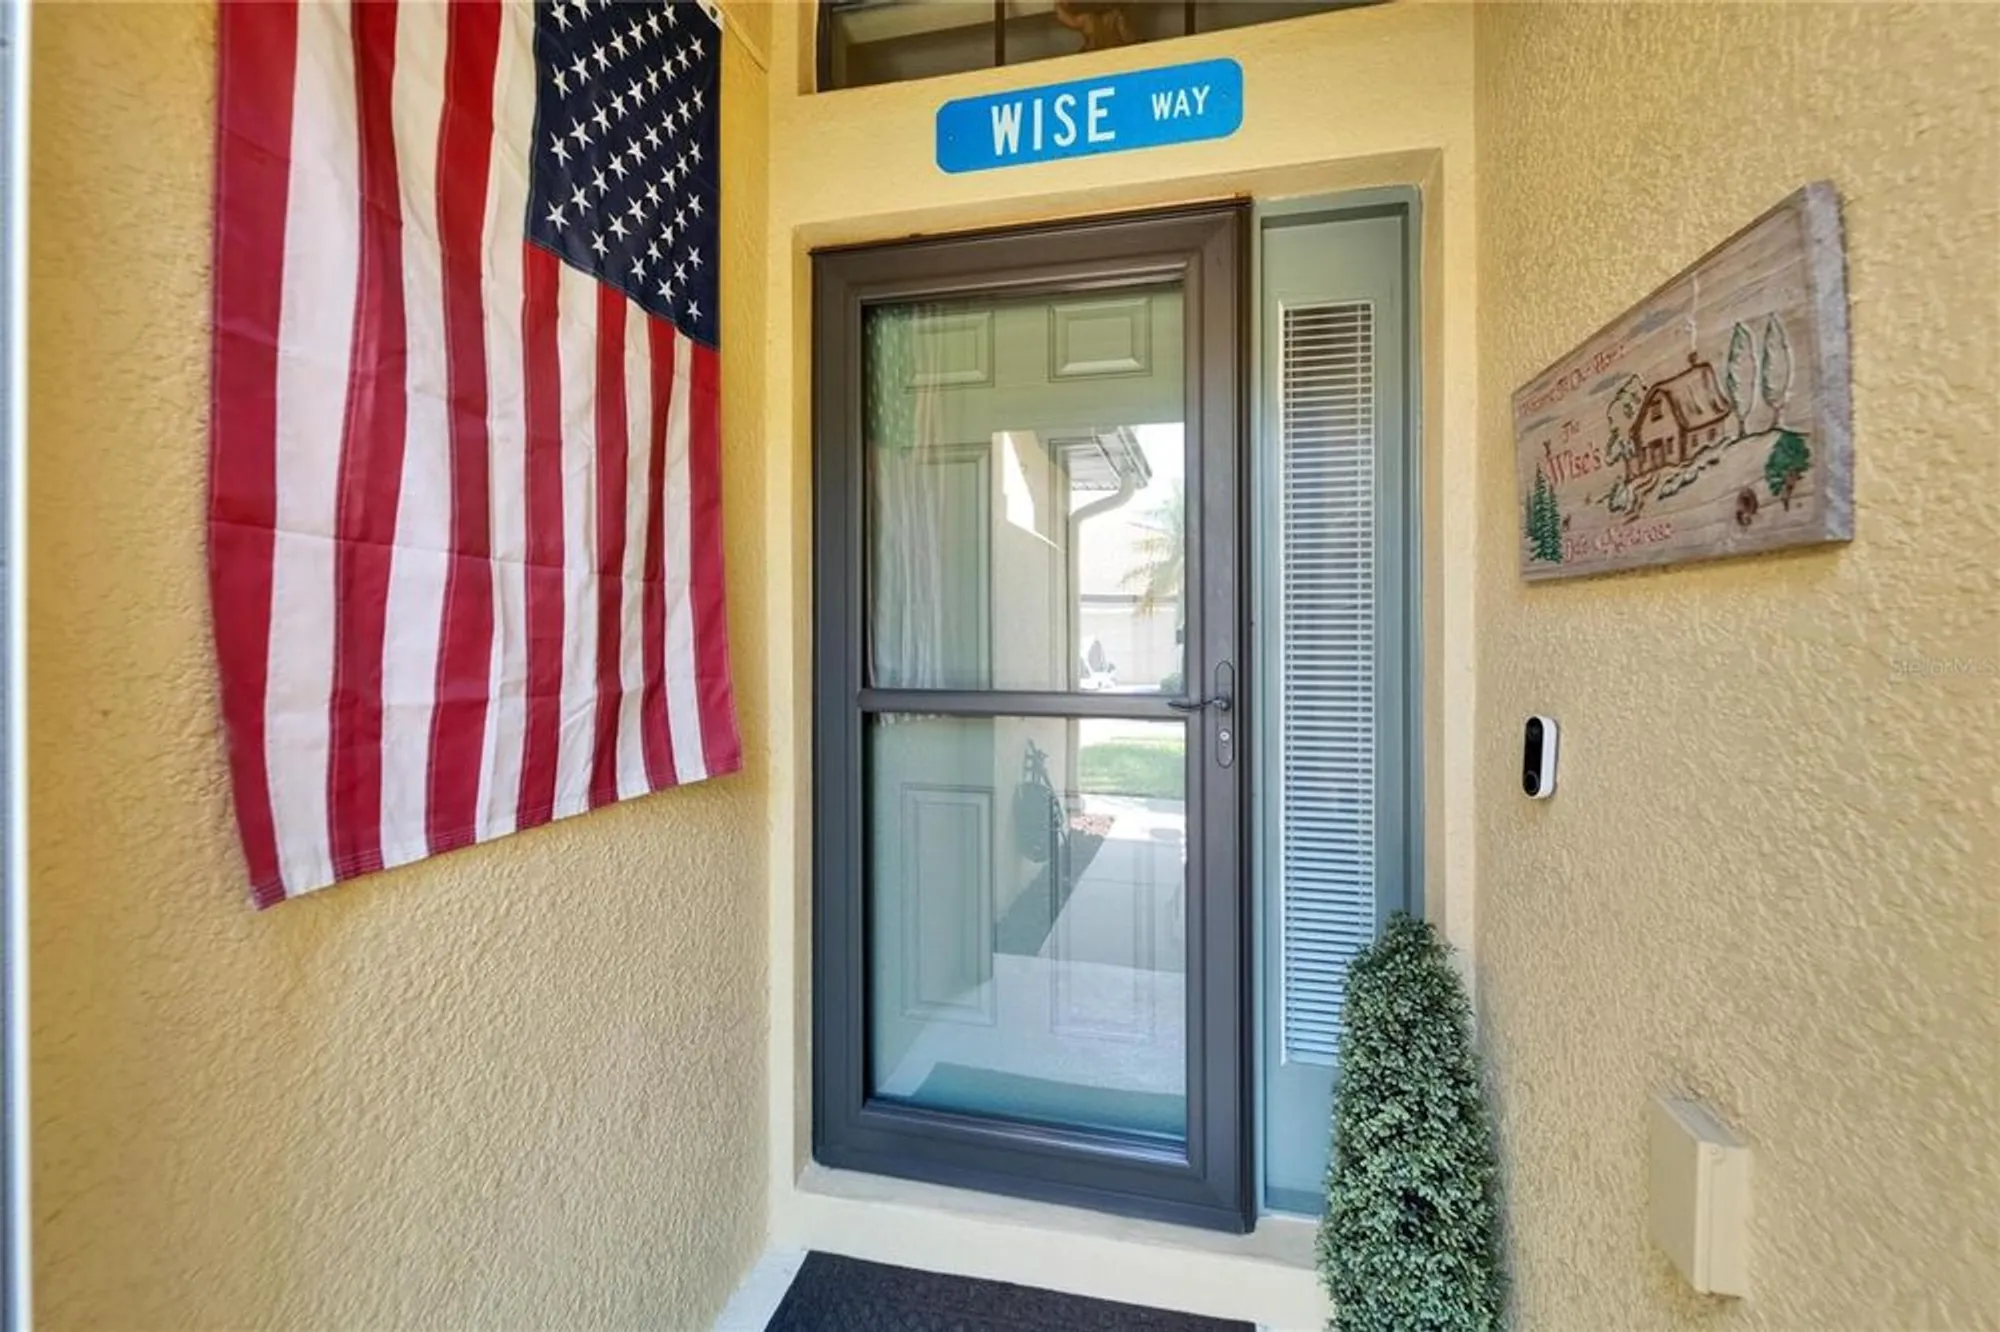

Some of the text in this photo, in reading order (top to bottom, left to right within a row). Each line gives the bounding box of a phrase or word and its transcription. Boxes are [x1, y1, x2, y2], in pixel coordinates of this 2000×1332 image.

[991, 85, 1210, 156] WISE WAY
[1544, 441, 1602, 487] Wise's
